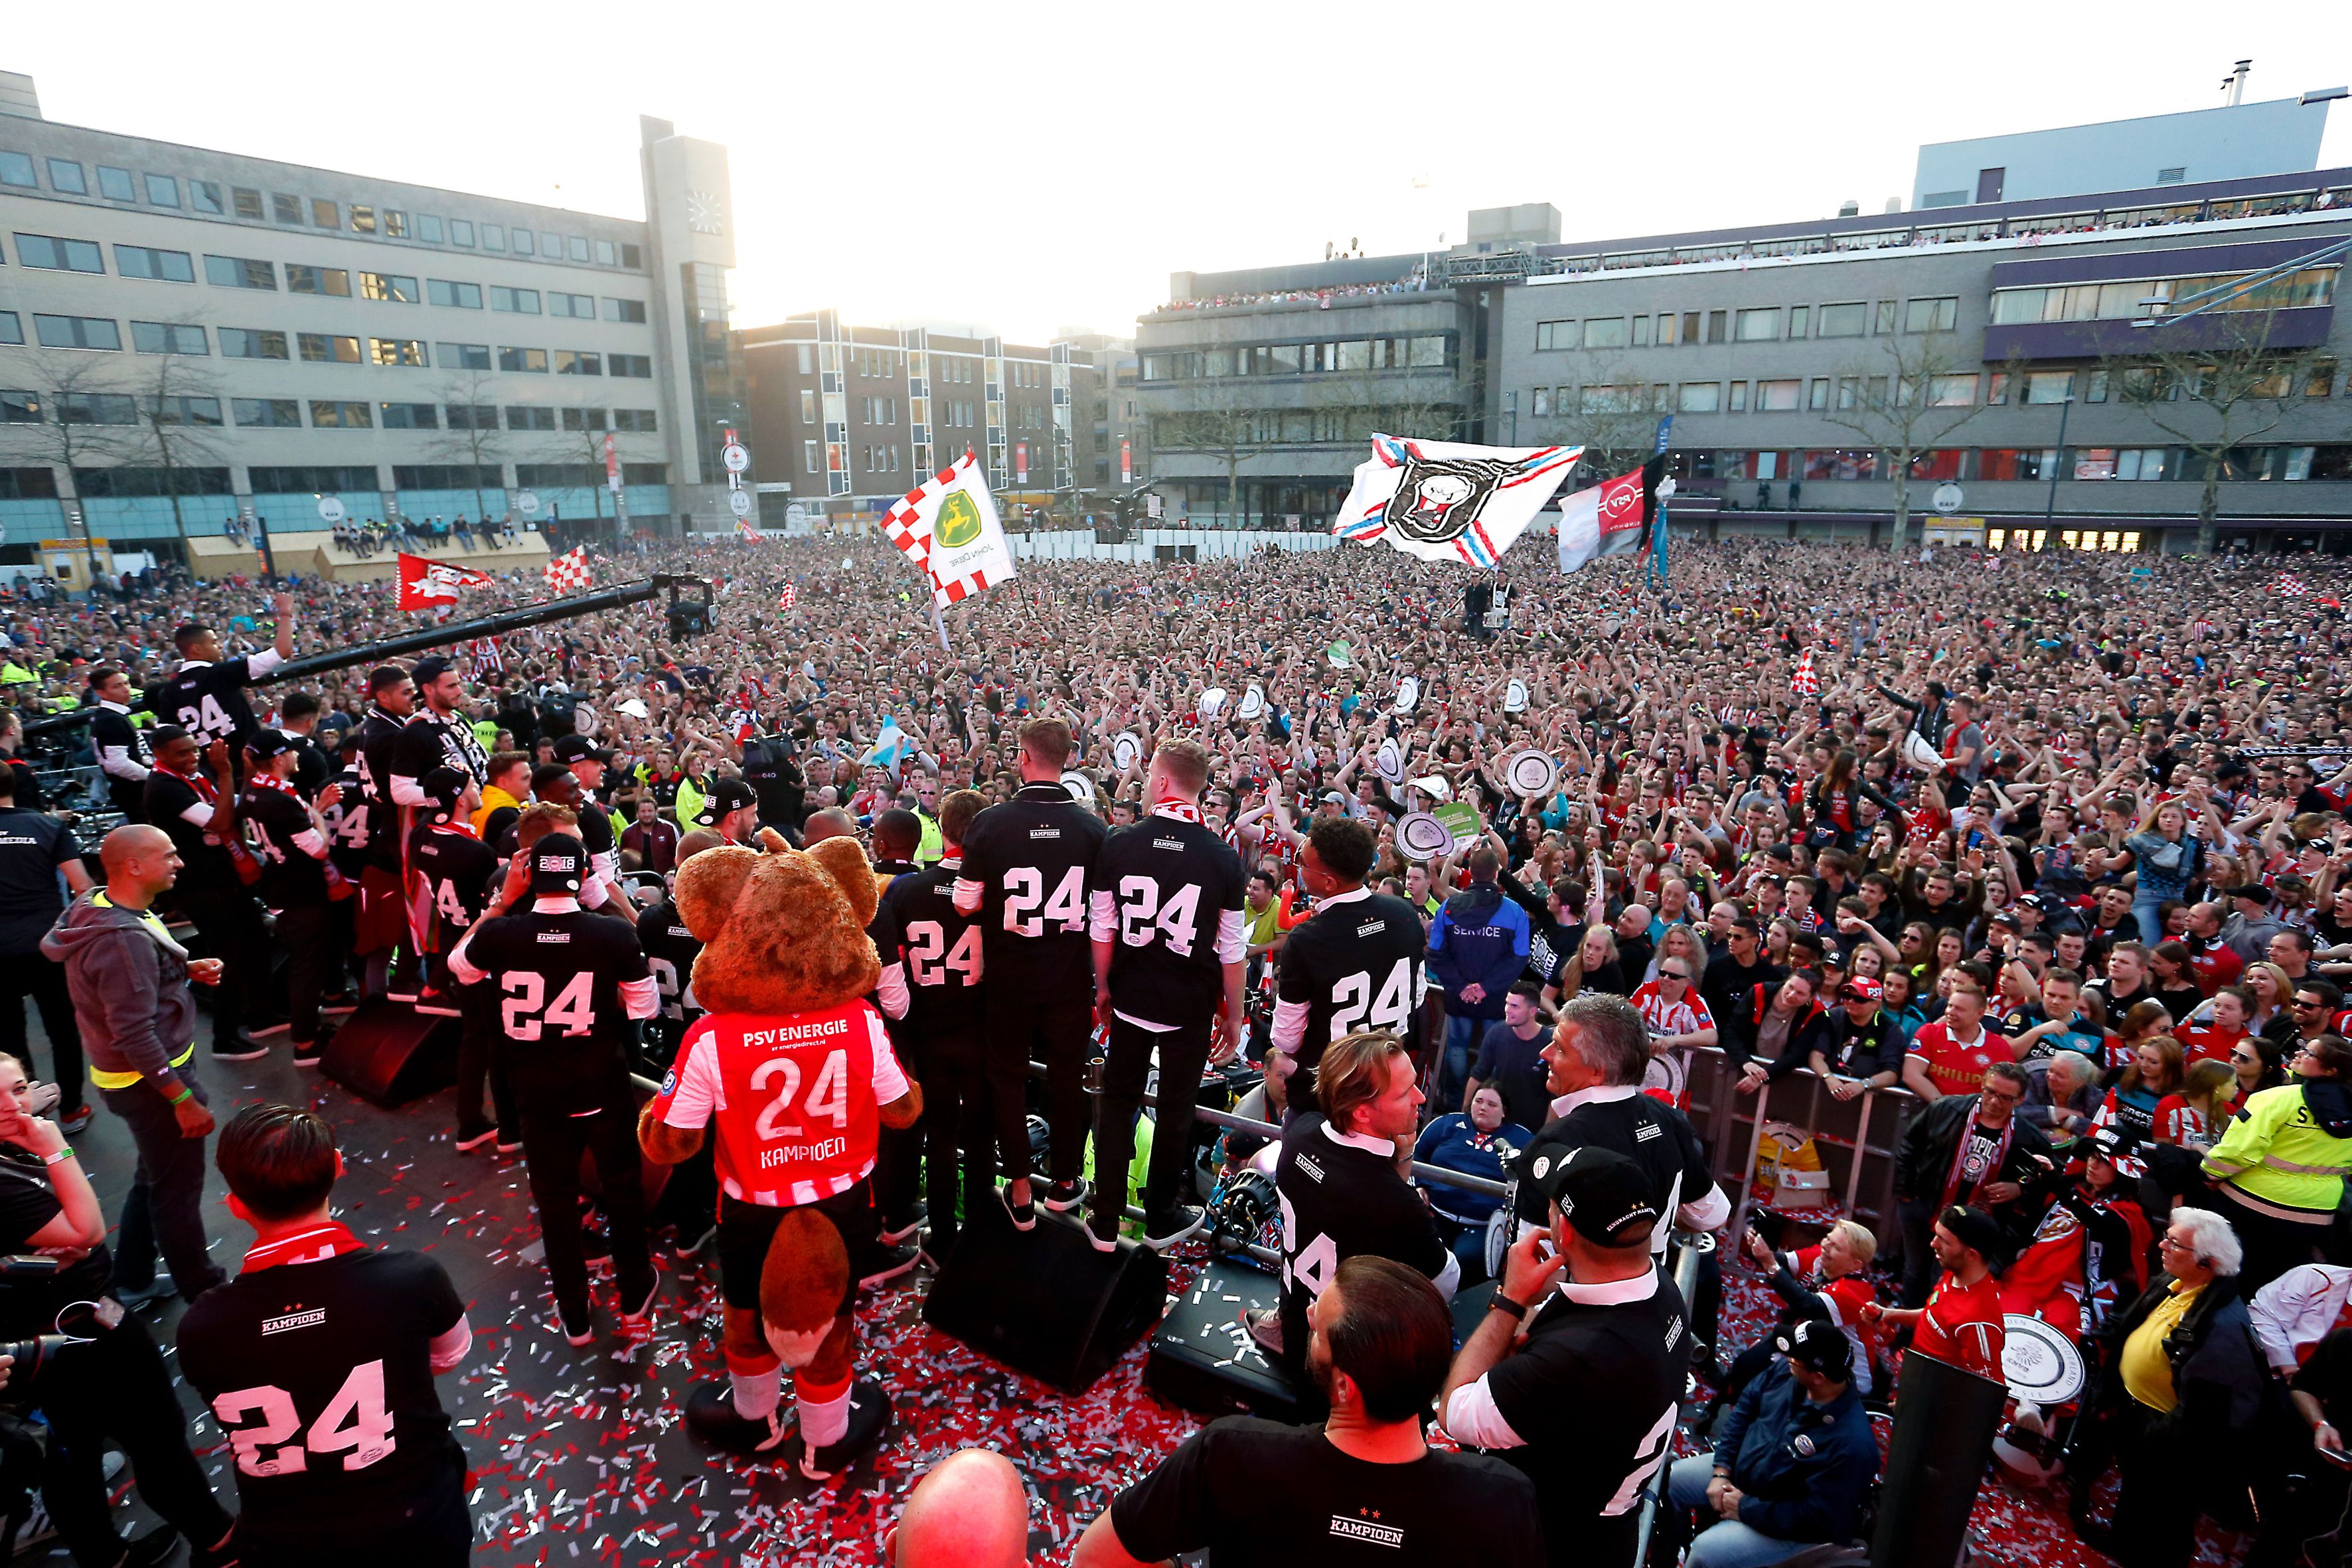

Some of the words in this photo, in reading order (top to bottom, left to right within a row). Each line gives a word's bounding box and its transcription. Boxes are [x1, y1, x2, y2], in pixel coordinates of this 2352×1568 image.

[177, 694, 236, 747] 24
[1153, 839, 1185, 851] KAMPIOEN
[1003, 866, 1086, 937] 24
[1120, 875, 1202, 958] 24
[1358, 921, 1386, 937] KAMPIOEN
[537, 934, 570, 943] KAMPIOEN
[1454, 924, 1501, 937] SERVICE
[907, 921, 984, 986] 24
[502, 971, 596, 1041] 24
[1330, 957, 1412, 1043] 24
[744, 1028, 775, 1047] PSV
[779, 1020, 848, 1043] ENERGIE
[779, 1038, 826, 1050] energiedirect.nl
[1929, 1063, 1982, 1084] PHILIP
[751, 1049, 848, 1142] 24
[2122, 1105, 2153, 1121] energ
[761, 1137, 846, 1169] KAMPIOEN
[1296, 1155, 1324, 1180] KAMPIOEN
[1607, 1211, 1637, 1232] EENDRACHT
[262, 1312, 325, 1333] KAMPIOEN
[1665, 1317, 1683, 1348] KAMPIOEN
[2034, 1325, 2053, 1336] VAN
[2056, 1340, 2078, 1387] NEDERLAND
[212, 1359, 396, 1478] 24
[1330, 1519, 1403, 1545] KAMPIOEN
